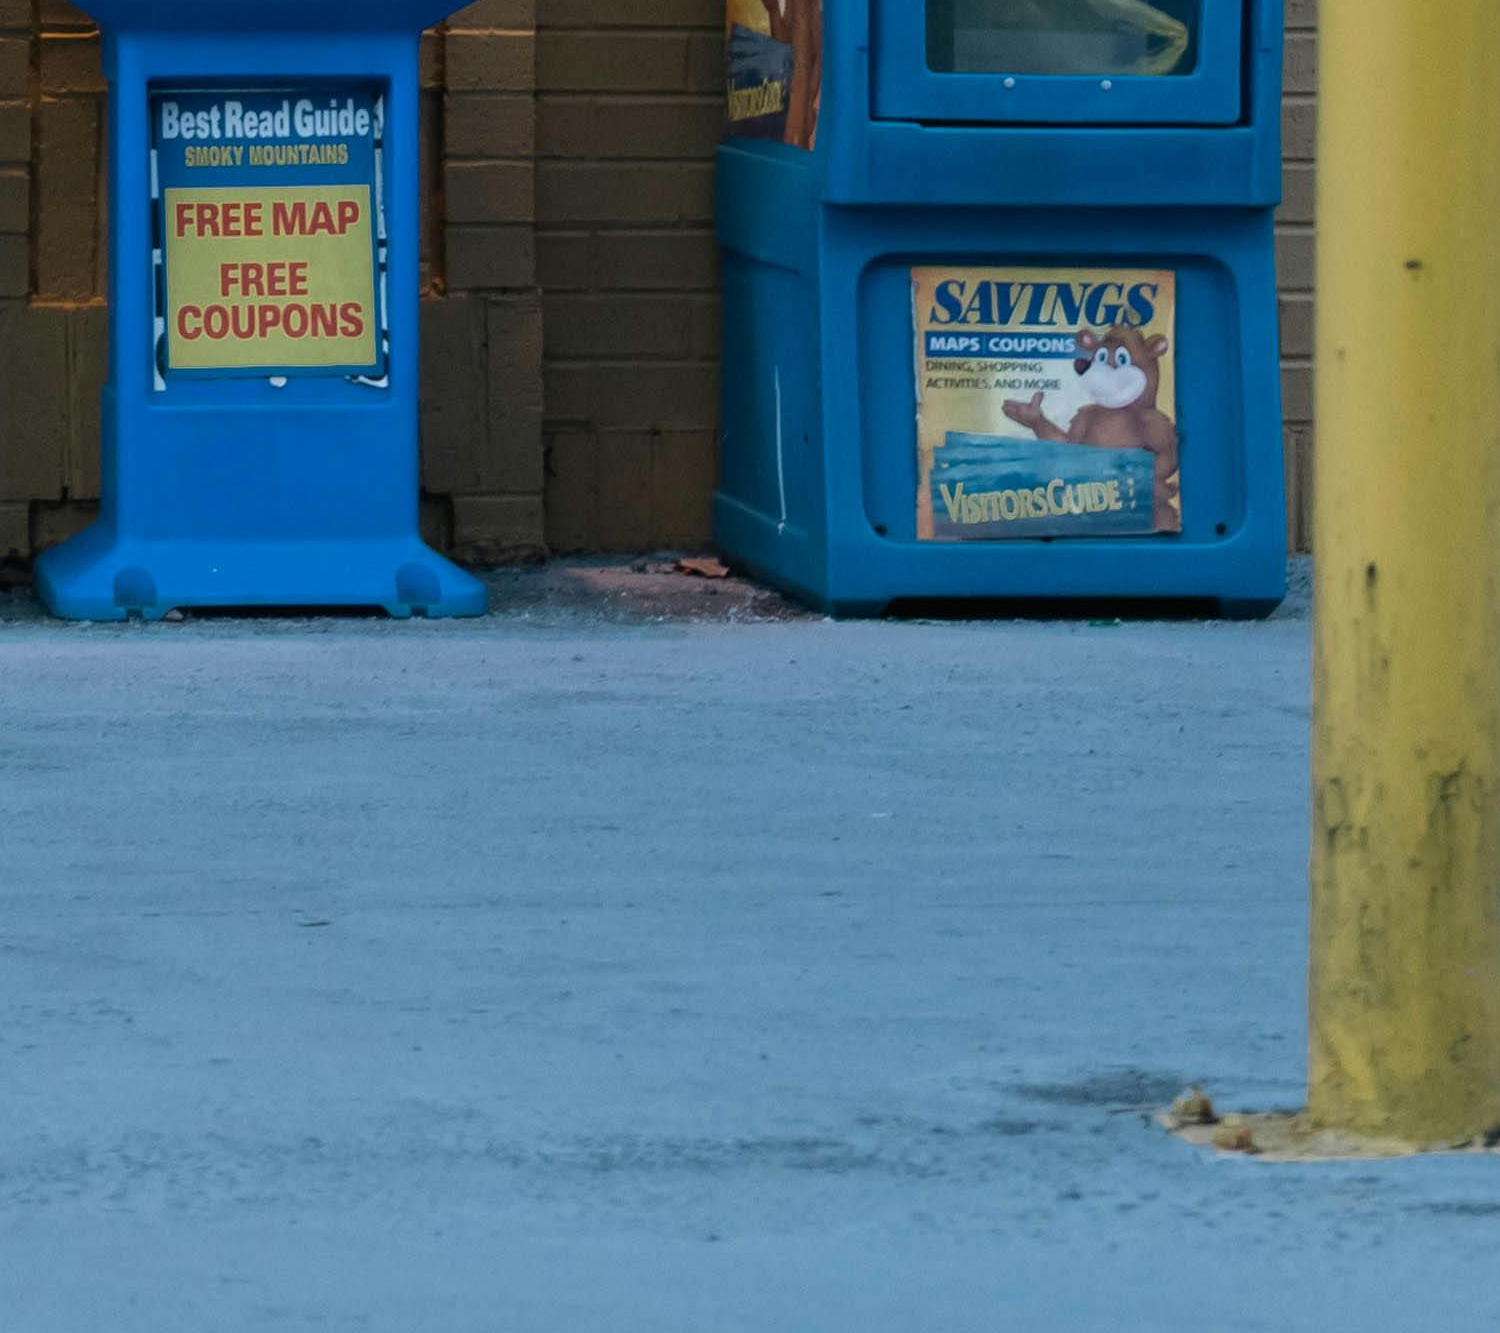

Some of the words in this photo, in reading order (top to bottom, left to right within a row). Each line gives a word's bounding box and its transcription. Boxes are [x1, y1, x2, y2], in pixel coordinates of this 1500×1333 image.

[162, 102, 221, 140] Best
[225, 100, 290, 139] Read
[294, 98, 370, 138] Guide
[185, 146, 243, 167] SMOKY
[249, 144, 349, 166] MOUNTAINS
[176, 203, 263, 239] FREE
[272, 201, 360, 236] MAP
[220, 262, 309, 297] FREE
[929, 279, 1158, 327] SAVINGS
[177, 302, 364, 341] COUPONS
[929, 337, 980, 352] MAPS
[988, 337, 1076, 353] COUPONS
[925, 361, 975, 373] DINING,
[977, 361, 1043, 373] SHOPPING
[994, 378, 1022, 390] AND
[1024, 379, 1062, 390] MORE
